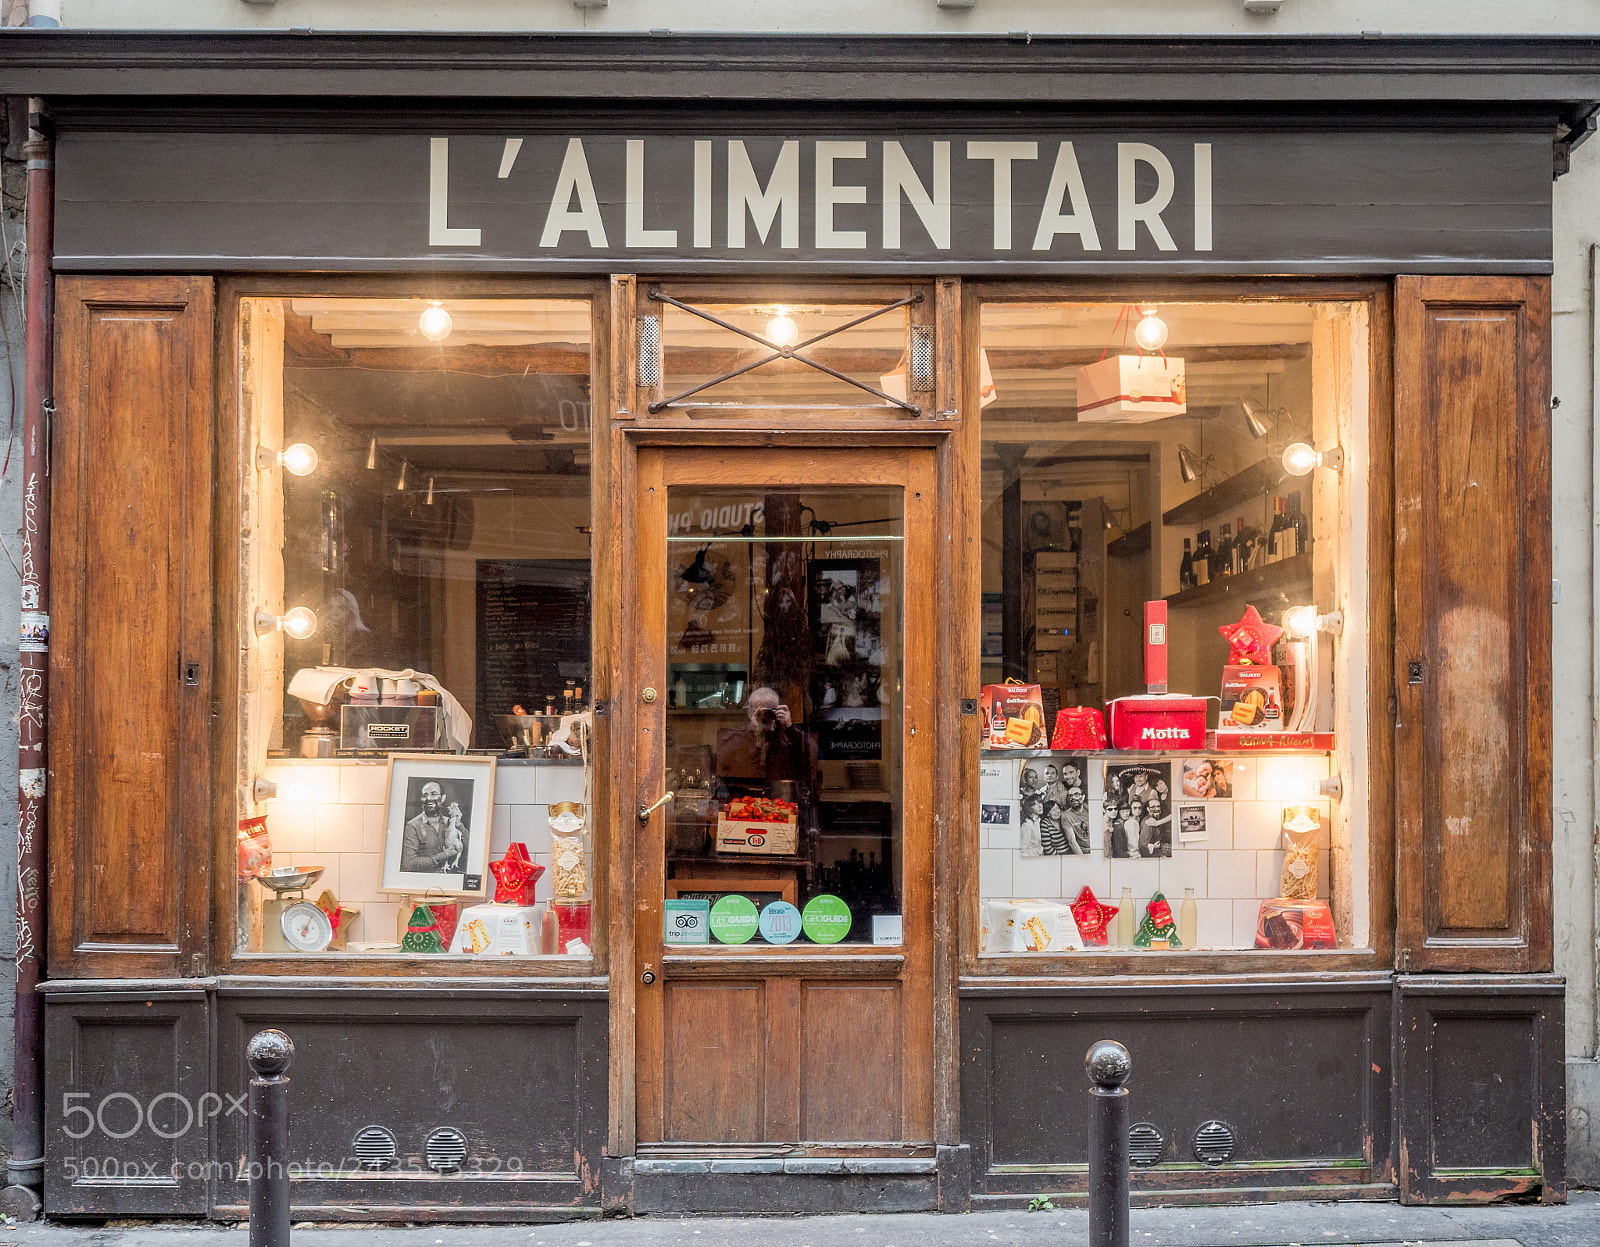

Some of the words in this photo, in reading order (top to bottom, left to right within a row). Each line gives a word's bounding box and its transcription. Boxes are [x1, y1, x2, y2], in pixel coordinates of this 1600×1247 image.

[428, 137, 1213, 252] L'ALIMENTARI
[1141, 727, 1191, 740] Motta
[711, 915, 757, 925] GEOGUIDE
[768, 915, 792, 932] 2013
[804, 914, 849, 923] GEOGUIDE
[669, 930, 705, 938] tripadvisor
